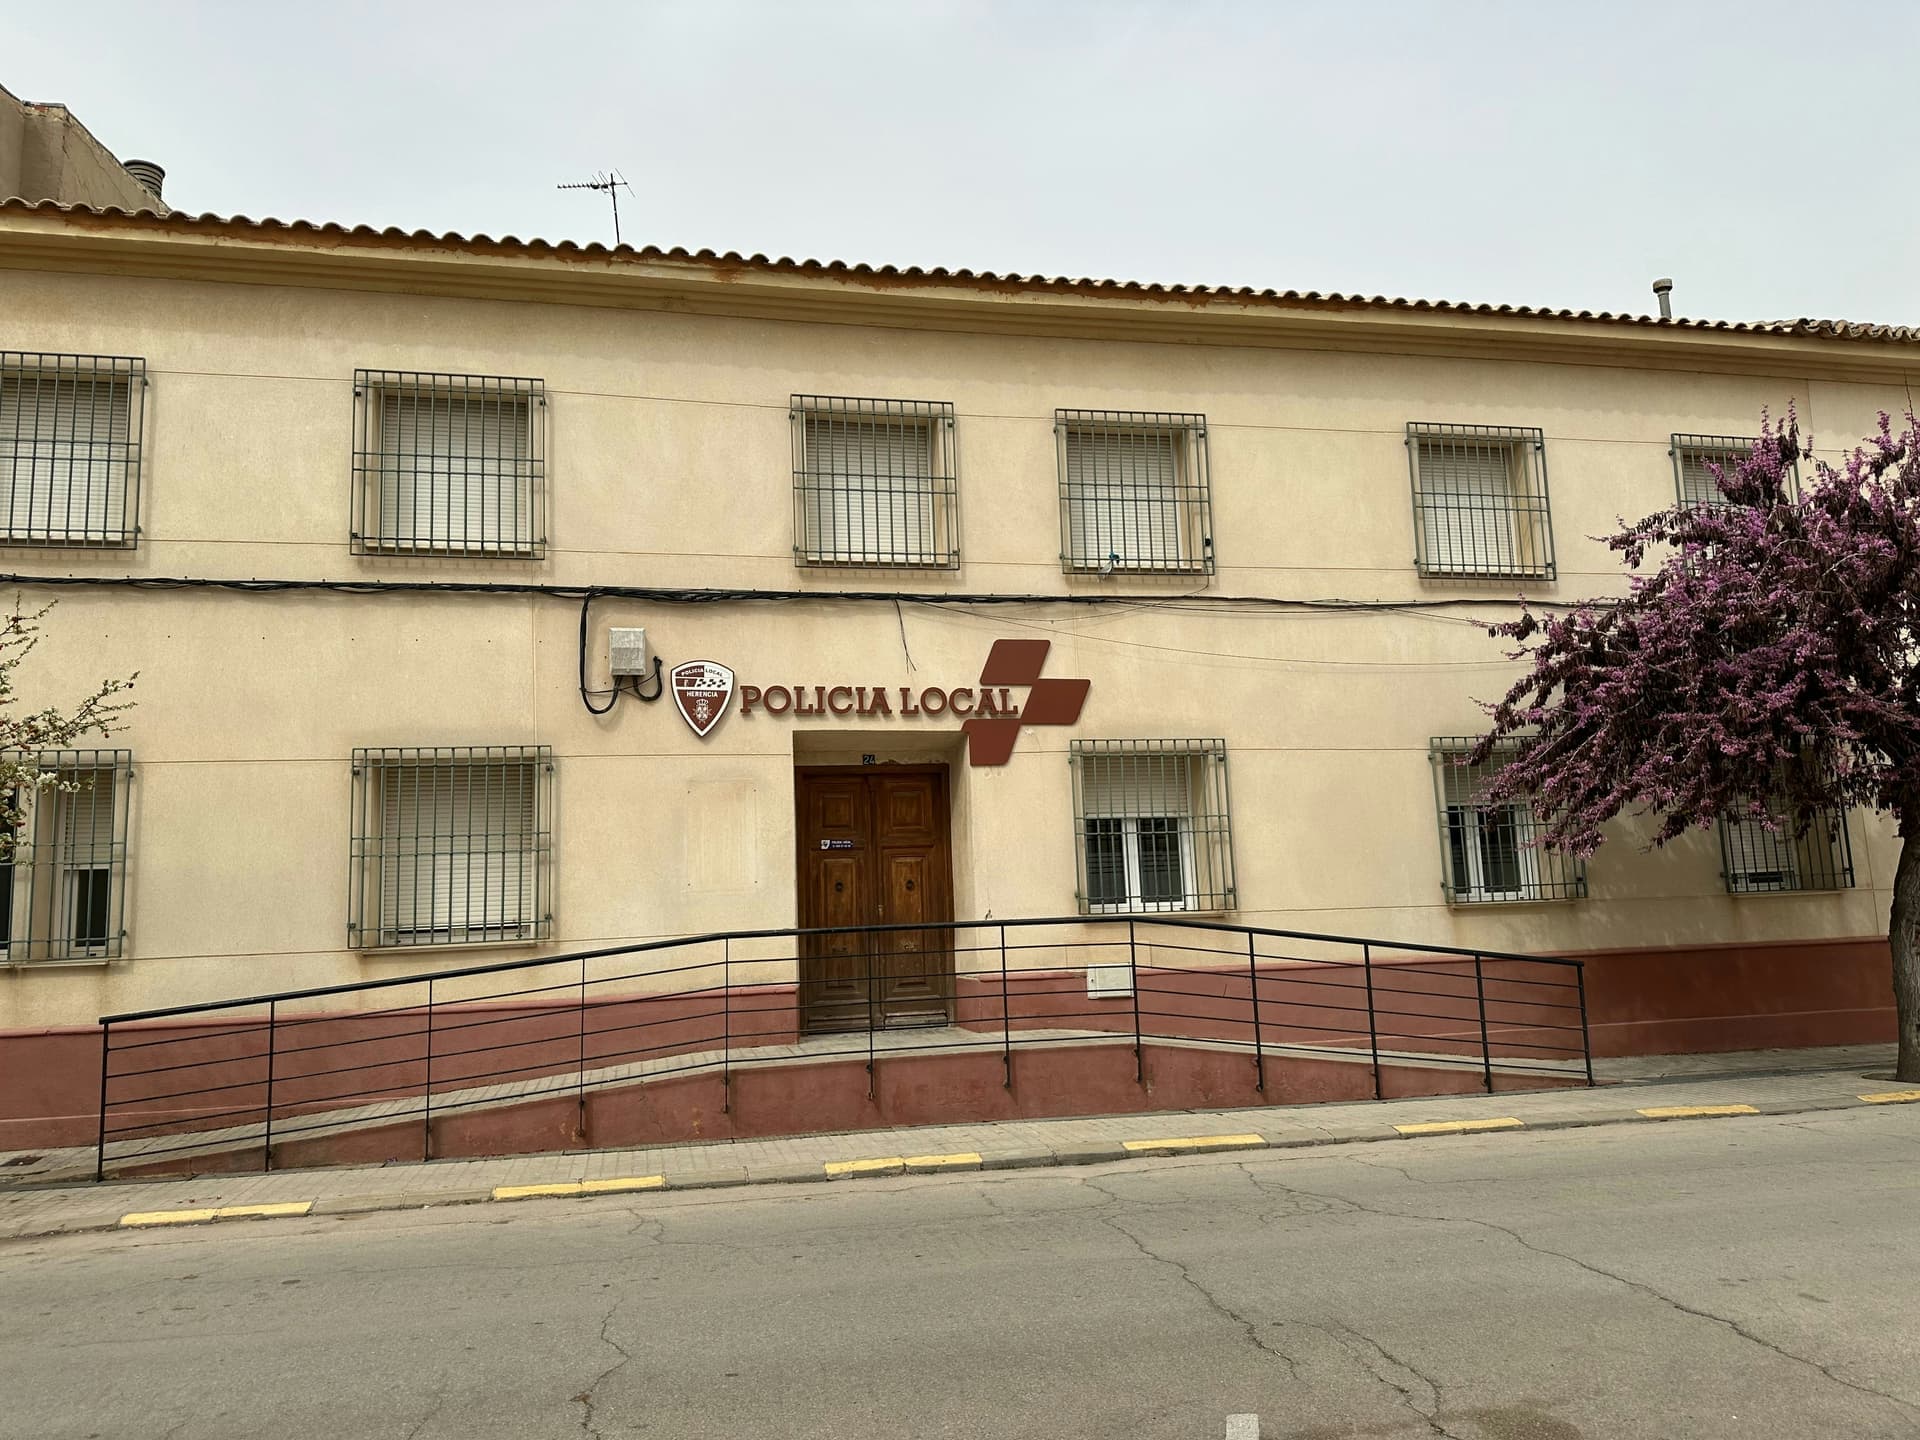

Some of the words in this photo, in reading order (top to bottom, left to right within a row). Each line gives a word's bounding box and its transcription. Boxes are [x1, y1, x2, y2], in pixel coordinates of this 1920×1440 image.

[681, 668, 704, 676] POLICIA
[705, 668, 723, 677] LOCAL
[740, 685, 892, 715] POLICIA
[899, 686, 1018, 715] LOCAL
[863, 755, 875, 765] 24
